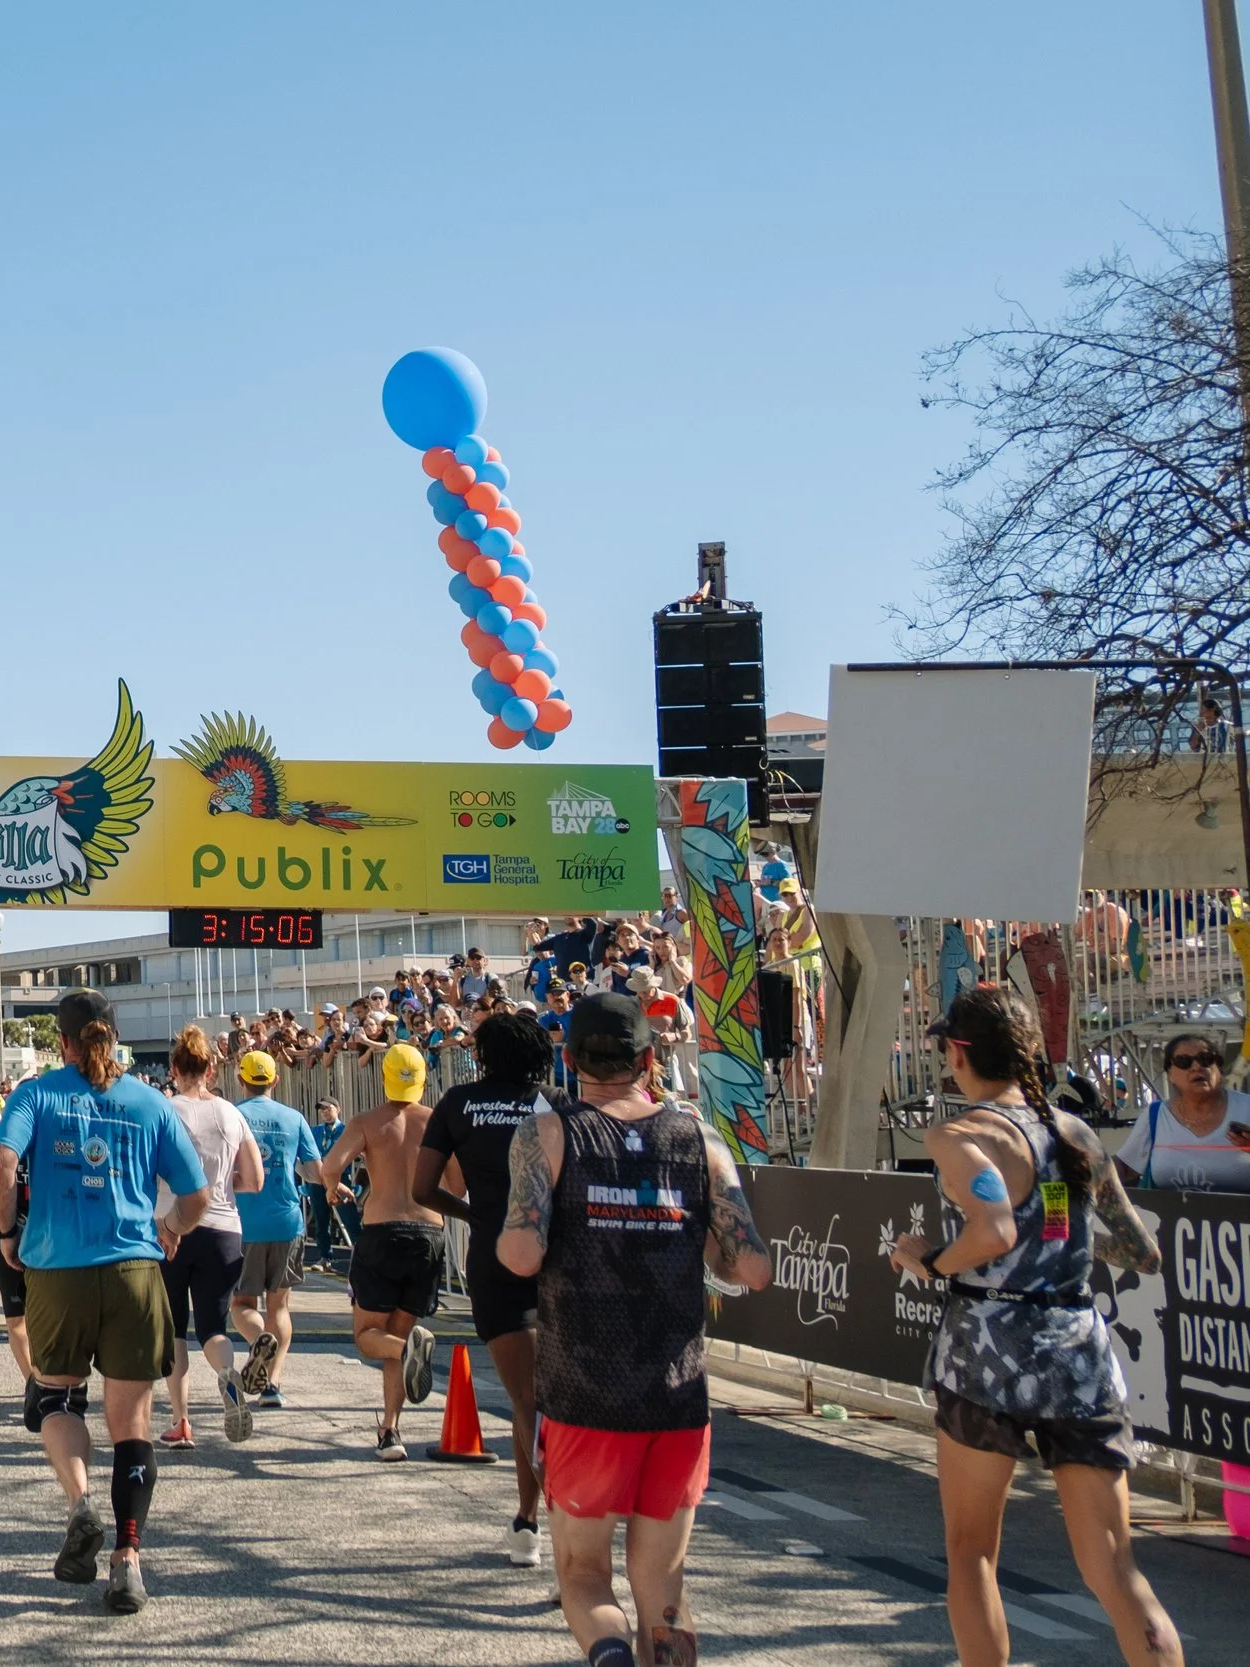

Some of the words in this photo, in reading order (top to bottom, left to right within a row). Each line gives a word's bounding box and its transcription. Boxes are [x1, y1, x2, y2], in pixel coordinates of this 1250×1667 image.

[450, 790, 516, 807] ROOMS
[548, 800, 617, 818] TAMPA
[451, 812, 473, 827] TO
[477, 812, 508, 828] GO
[552, 817, 591, 834] BAY
[594, 818, 617, 834] 28
[616, 822, 630, 830] abc
[193, 844, 389, 891] Publix
[452, 860, 487, 874] TGH
[493, 854, 530, 866] Tampa
[573, 853, 599, 869] City
[493, 863, 536, 875] General
[557, 858, 626, 888] Tampa
[5, 873, 54, 884] CLASSIC
[494, 874, 539, 886] Hospital
[462, 1099, 515, 1115] Invested
[518, 1102, 533, 1113] in
[472, 1111, 523, 1127] Wellnes
[586, 1205, 666, 1220] MARYLAND
[587, 1218, 623, 1229] SWIM
[625, 1220, 656, 1231] BIKE
[658, 1221, 684, 1231] RUN
[788, 1225, 817, 1260] City
[770, 1238, 849, 1313] Tampa
[825, 1298, 846, 1312] Florida
[895, 1292, 942, 1326] Recre
[896, 1325, 920, 1339] CITY
